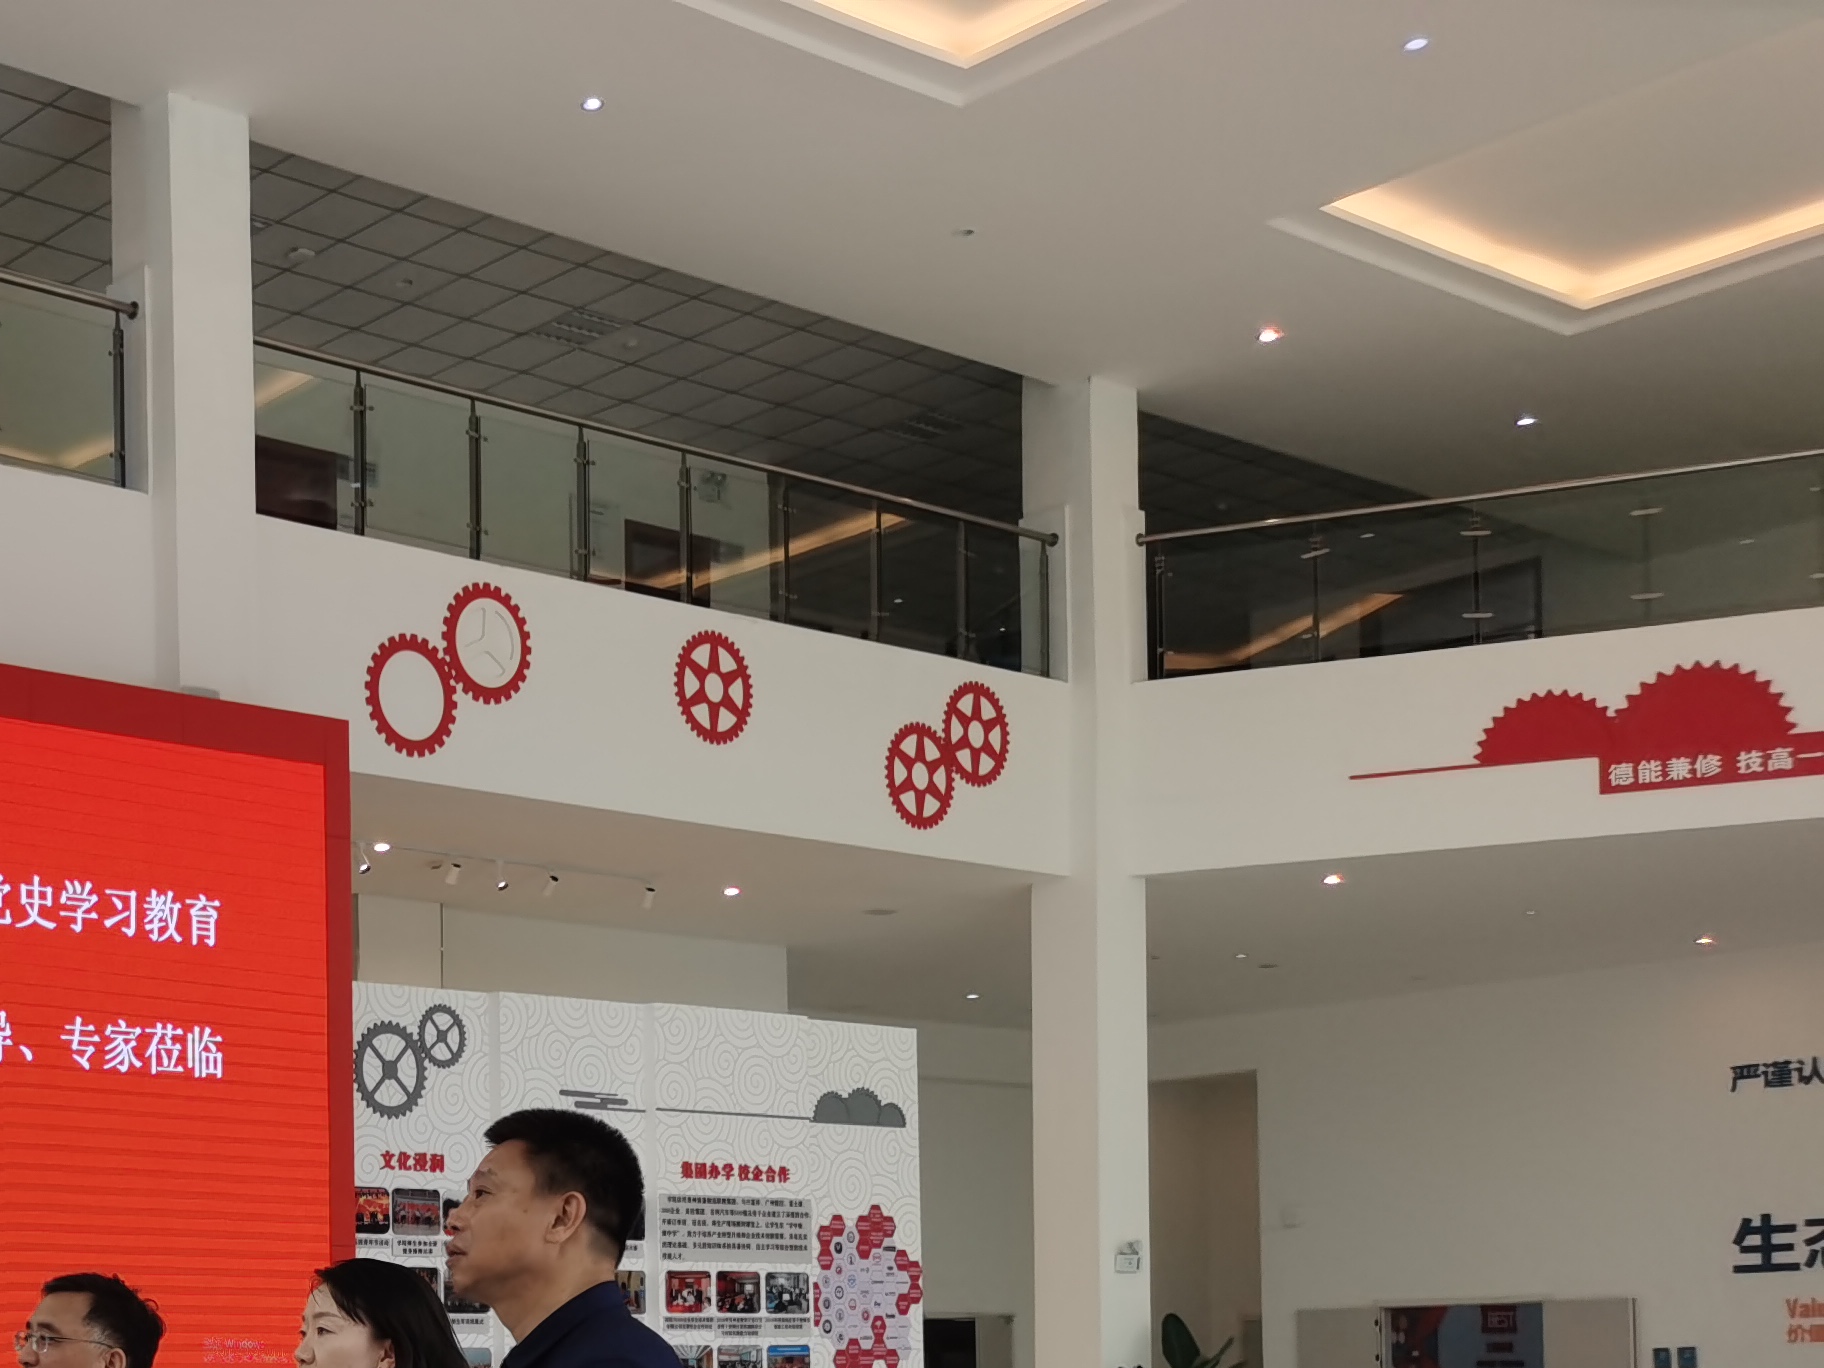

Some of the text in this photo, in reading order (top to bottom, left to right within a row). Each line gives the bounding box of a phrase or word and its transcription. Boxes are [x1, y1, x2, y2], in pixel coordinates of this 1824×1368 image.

[1608, 753, 1722, 787] 德能兼修
[680, 1162, 790, 1183] 集团办学 校企合作
